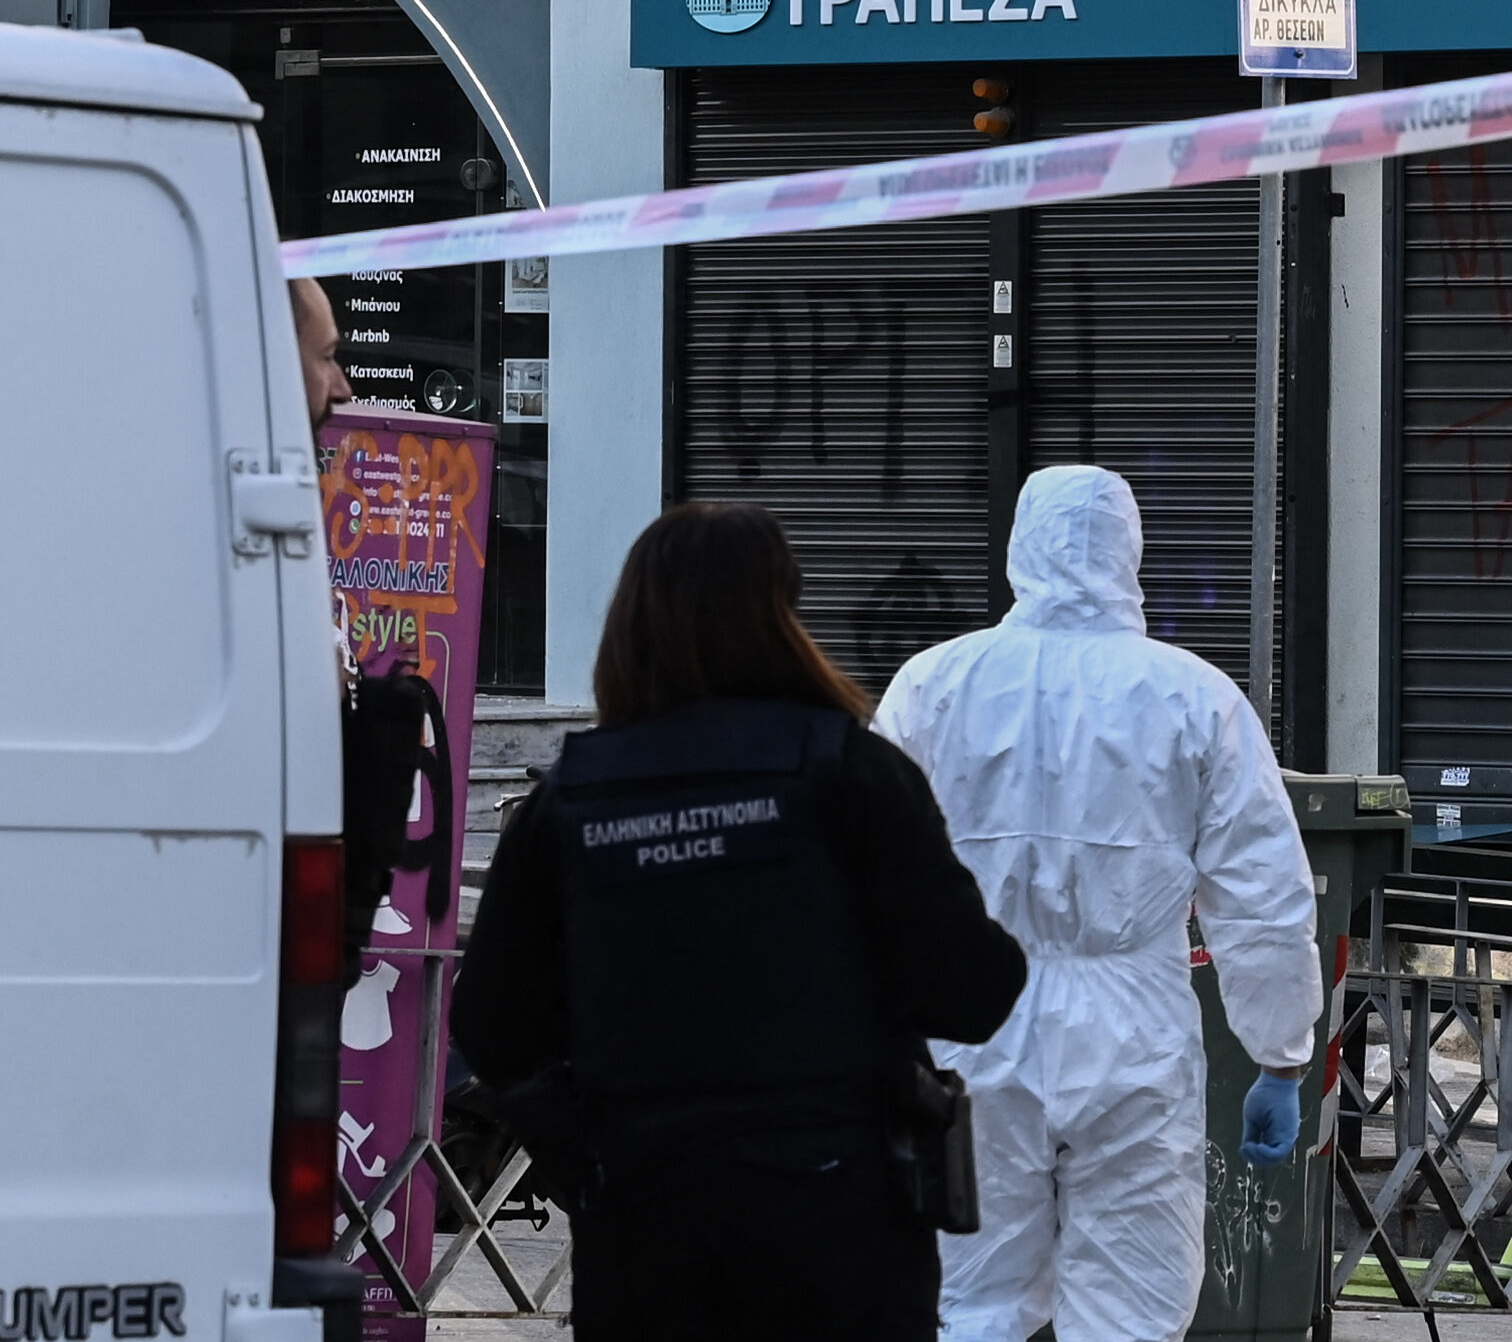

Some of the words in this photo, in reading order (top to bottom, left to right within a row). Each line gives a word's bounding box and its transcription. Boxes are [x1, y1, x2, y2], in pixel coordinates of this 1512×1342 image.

[1253, 18, 1272, 40] ΑΡ.
[1277, 19, 1325, 42] ΘΕΣΕΩΝ
[361, 148, 441, 163] ΑΝΑΚΑΙΝΙΣΗ
[331, 189, 415, 203] ΔΙΑΚΟΣΜΗΣΗ
[351, 298, 400, 313] Μπάνιου
[349, 365, 413, 382] Κατασκευή
[327, 557, 455, 594] ΑΛΟΝΙΚΗΣ
[583, 812, 673, 848] ΕΛΛΗΝΙΚΗ
[677, 797, 781, 834] ΑΣΤΥΝΟΜΙΑ
[637, 837, 726, 866] POLICE
